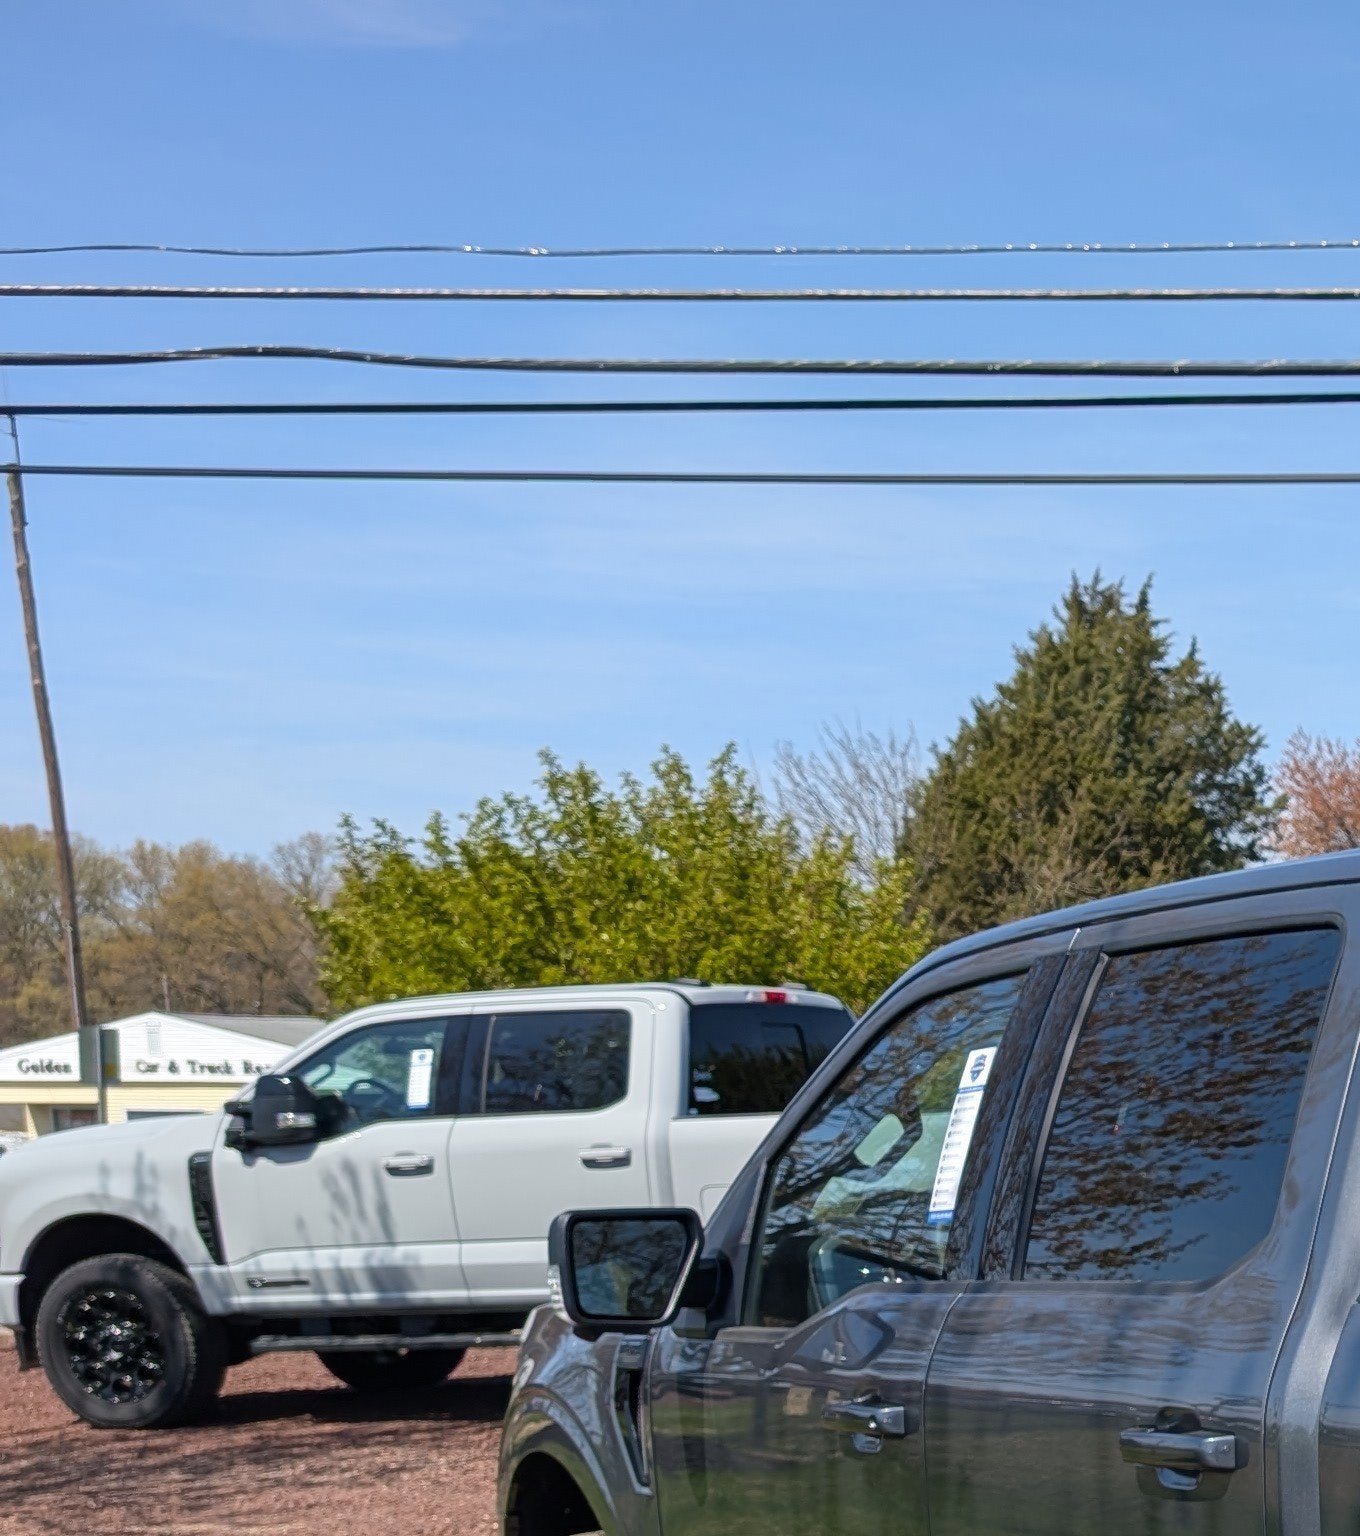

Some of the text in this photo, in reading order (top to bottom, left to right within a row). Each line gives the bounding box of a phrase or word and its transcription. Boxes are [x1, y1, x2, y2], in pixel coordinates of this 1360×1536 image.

[135, 1060, 159, 1074] Car
[168, 1060, 179, 1074] &
[186, 1060, 233, 1075] Truck
